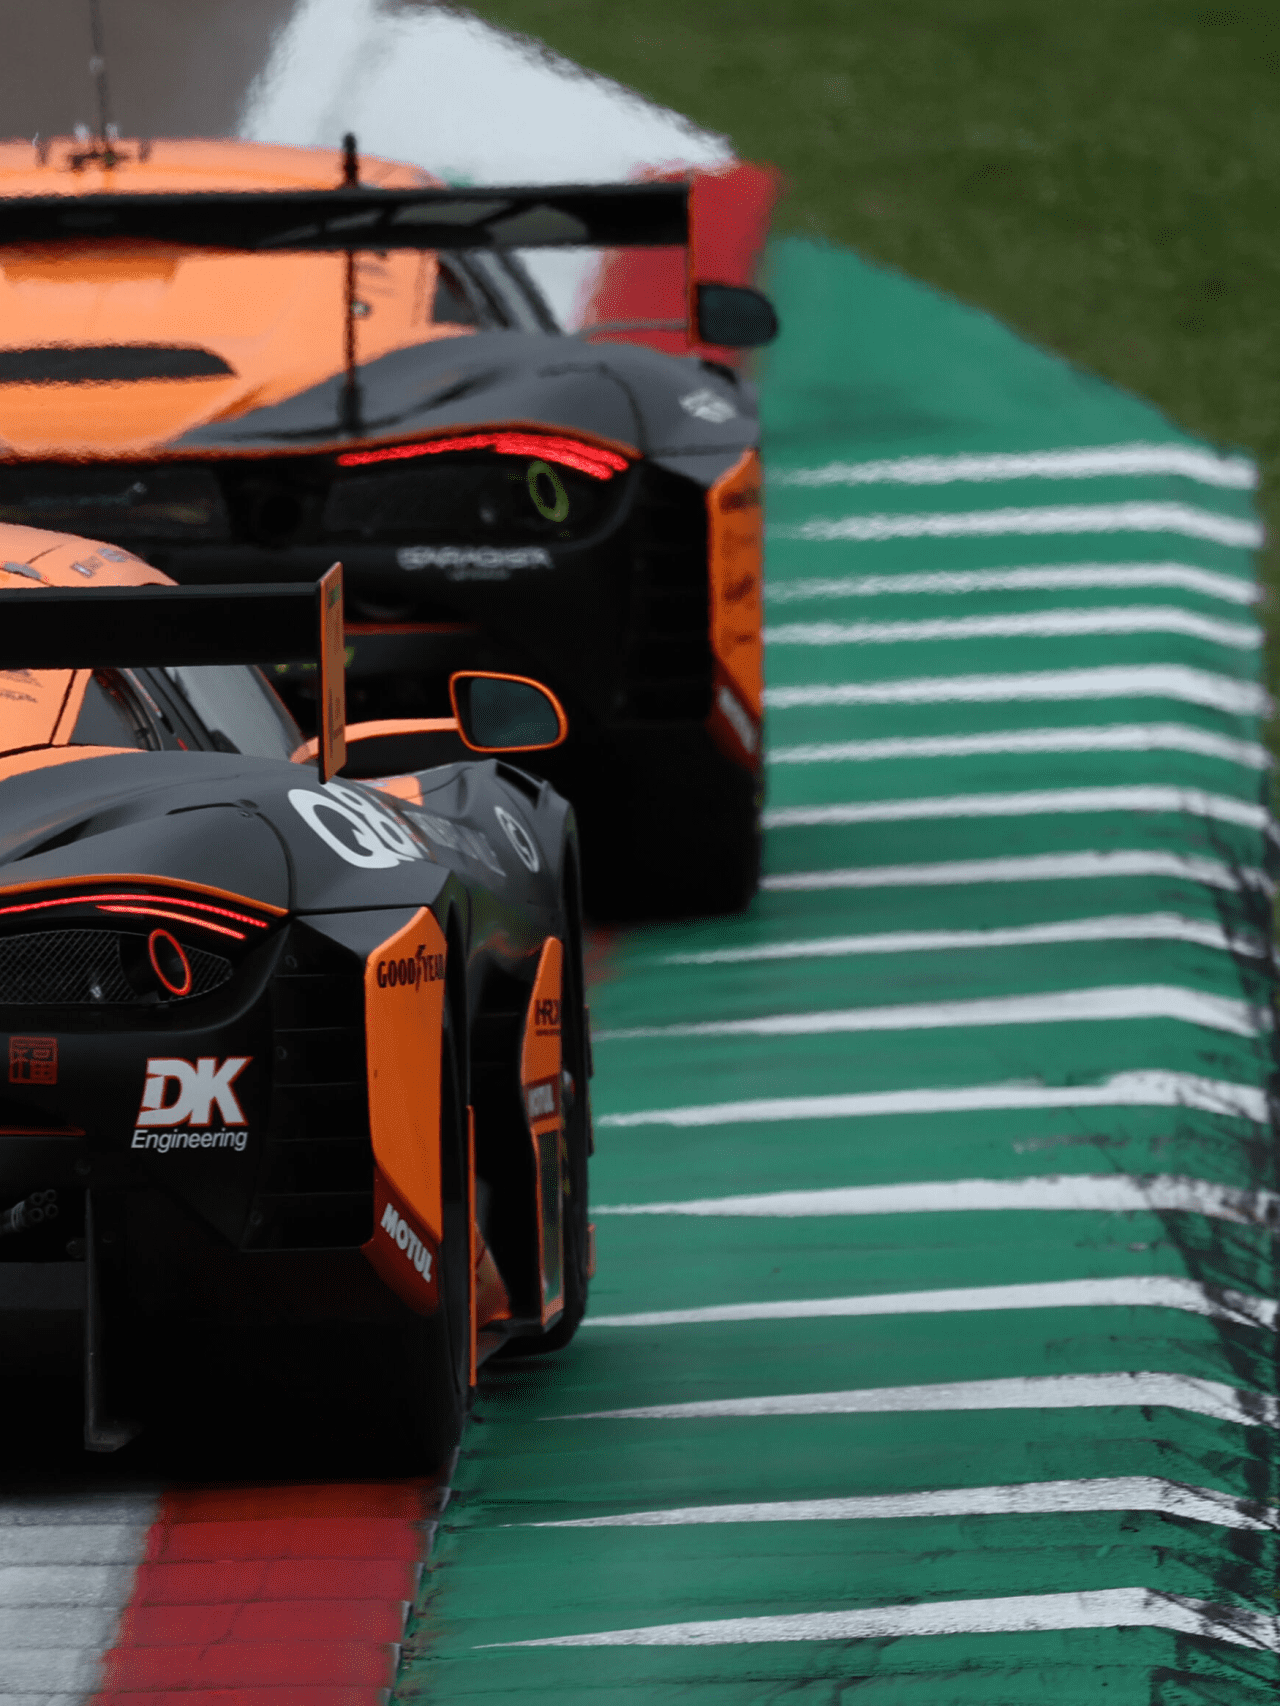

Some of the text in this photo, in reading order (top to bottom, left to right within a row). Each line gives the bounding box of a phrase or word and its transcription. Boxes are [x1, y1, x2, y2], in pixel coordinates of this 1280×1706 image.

[288, 782, 424, 870] Q8
[133, 1056, 253, 1128] DK
[131, 1127, 248, 1153] Engineering
[380, 1202, 433, 1283] MOTUL
